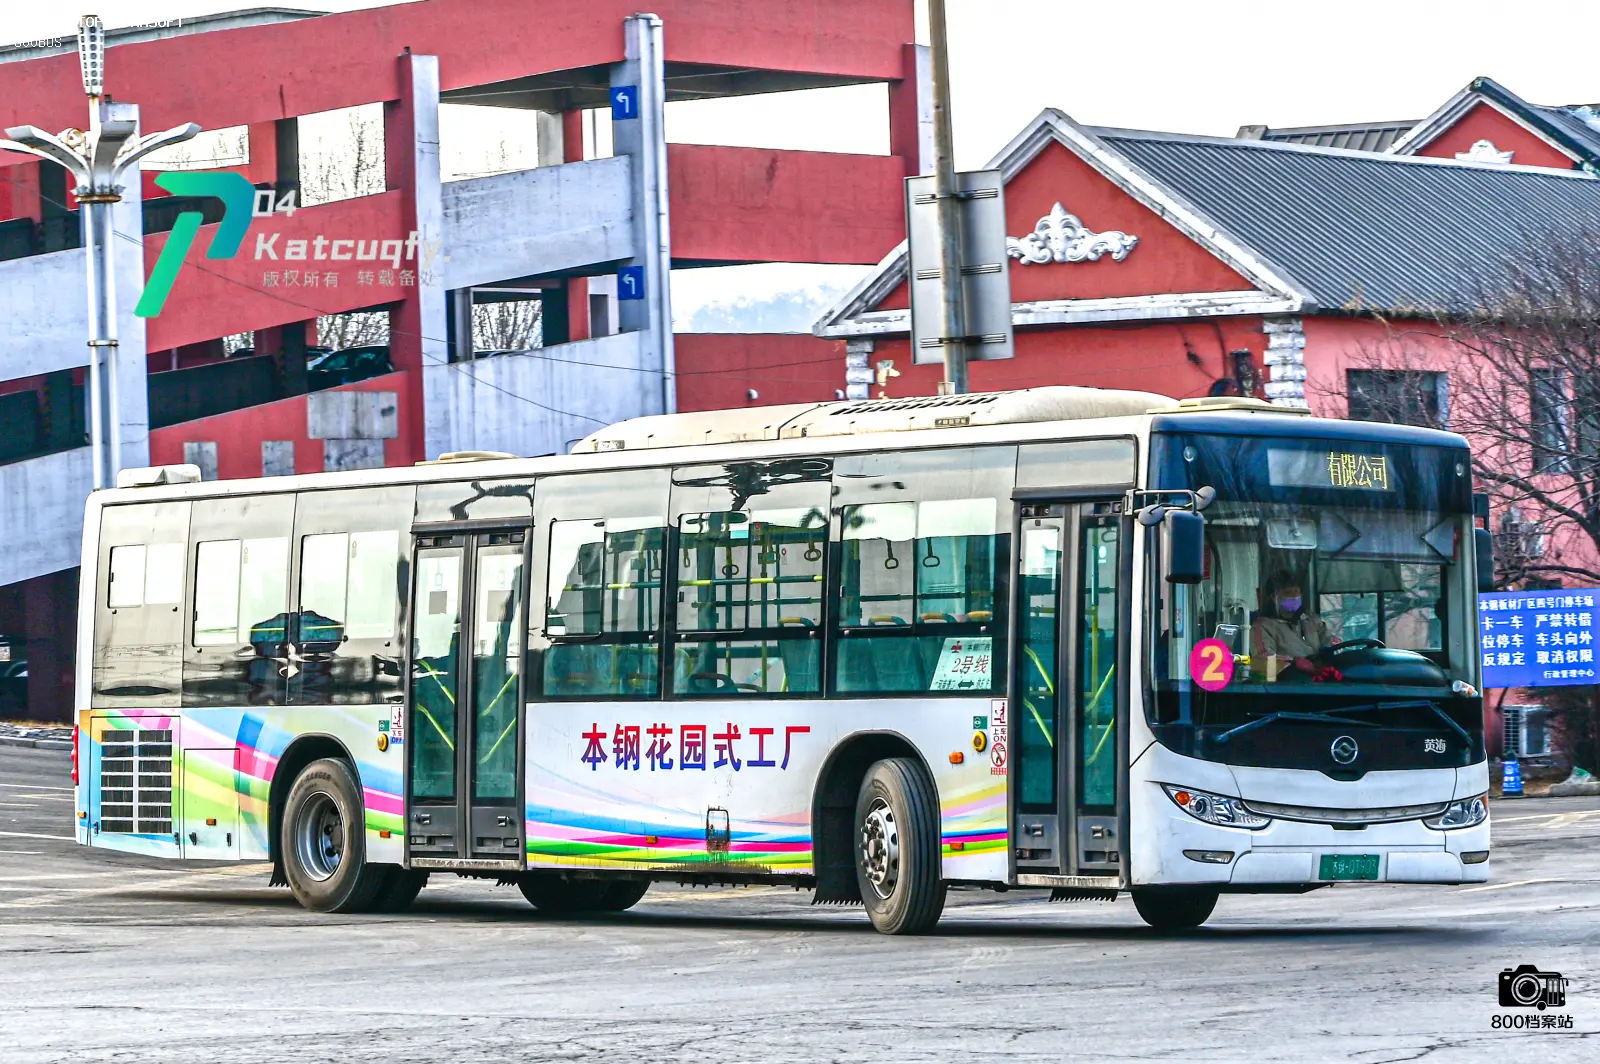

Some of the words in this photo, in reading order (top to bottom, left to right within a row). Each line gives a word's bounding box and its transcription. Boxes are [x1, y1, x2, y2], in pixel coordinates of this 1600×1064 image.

[1327, 452, 1388, 490] 有限公司
[1535, 612, 1592, 628] 严禁转借
[1536, 630, 1593, 646] 车头向外
[951, 655, 989, 674] 2号线
[1201, 645, 1224, 681] 2
[1536, 649, 1594, 664] 取消权限
[581, 723, 811, 771] 本钢花园式工厂
[993, 735, 1007, 743] ON
[1424, 738, 1446, 754] 黄海
